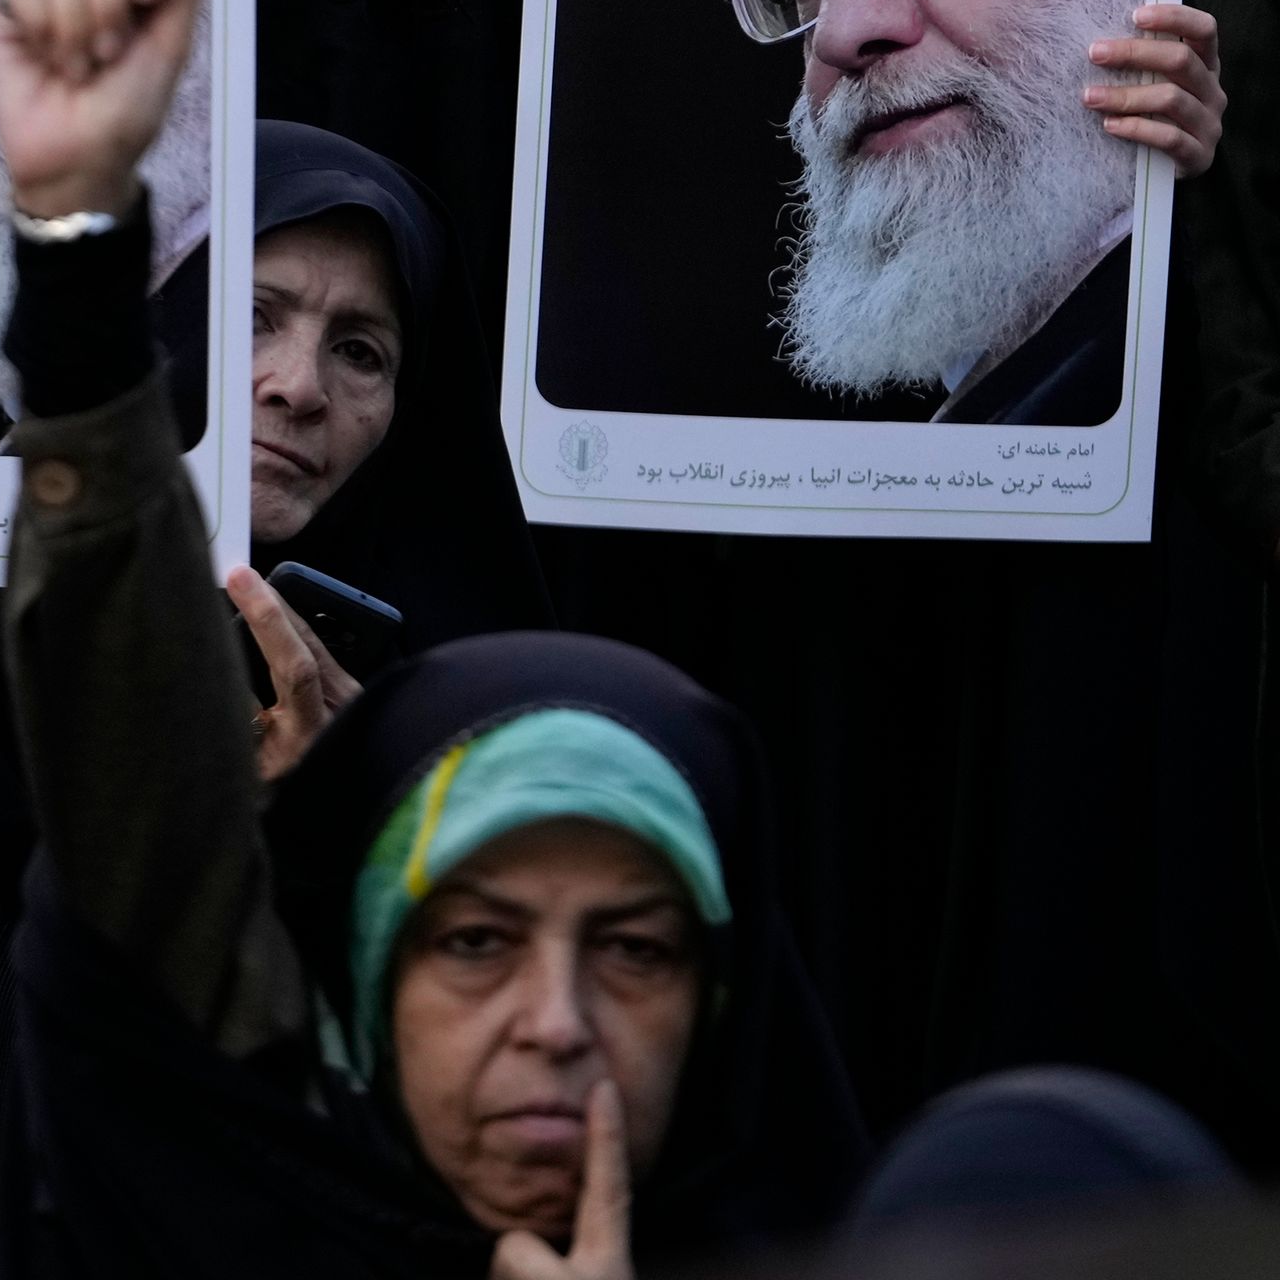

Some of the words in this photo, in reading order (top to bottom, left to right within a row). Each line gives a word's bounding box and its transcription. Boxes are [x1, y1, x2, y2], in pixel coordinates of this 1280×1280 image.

[997, 441, 1021, 460] ای:
[1025, 442, 1062, 457] خامنه
[1066, 442, 1095, 460] امام
[637, 464, 662, 484] بود
[669, 461, 724, 484] انقلاب
[729, 468, 791, 489] پیروزی
[810, 466, 841, 490] انبیا
[847, 468, 918, 492] معجزات
[923, 473, 942, 492] به
[947, 469, 995, 488] حادثه
[1001, 473, 1045, 495] ترین
[1051, 472, 1093, 495] شبیه
